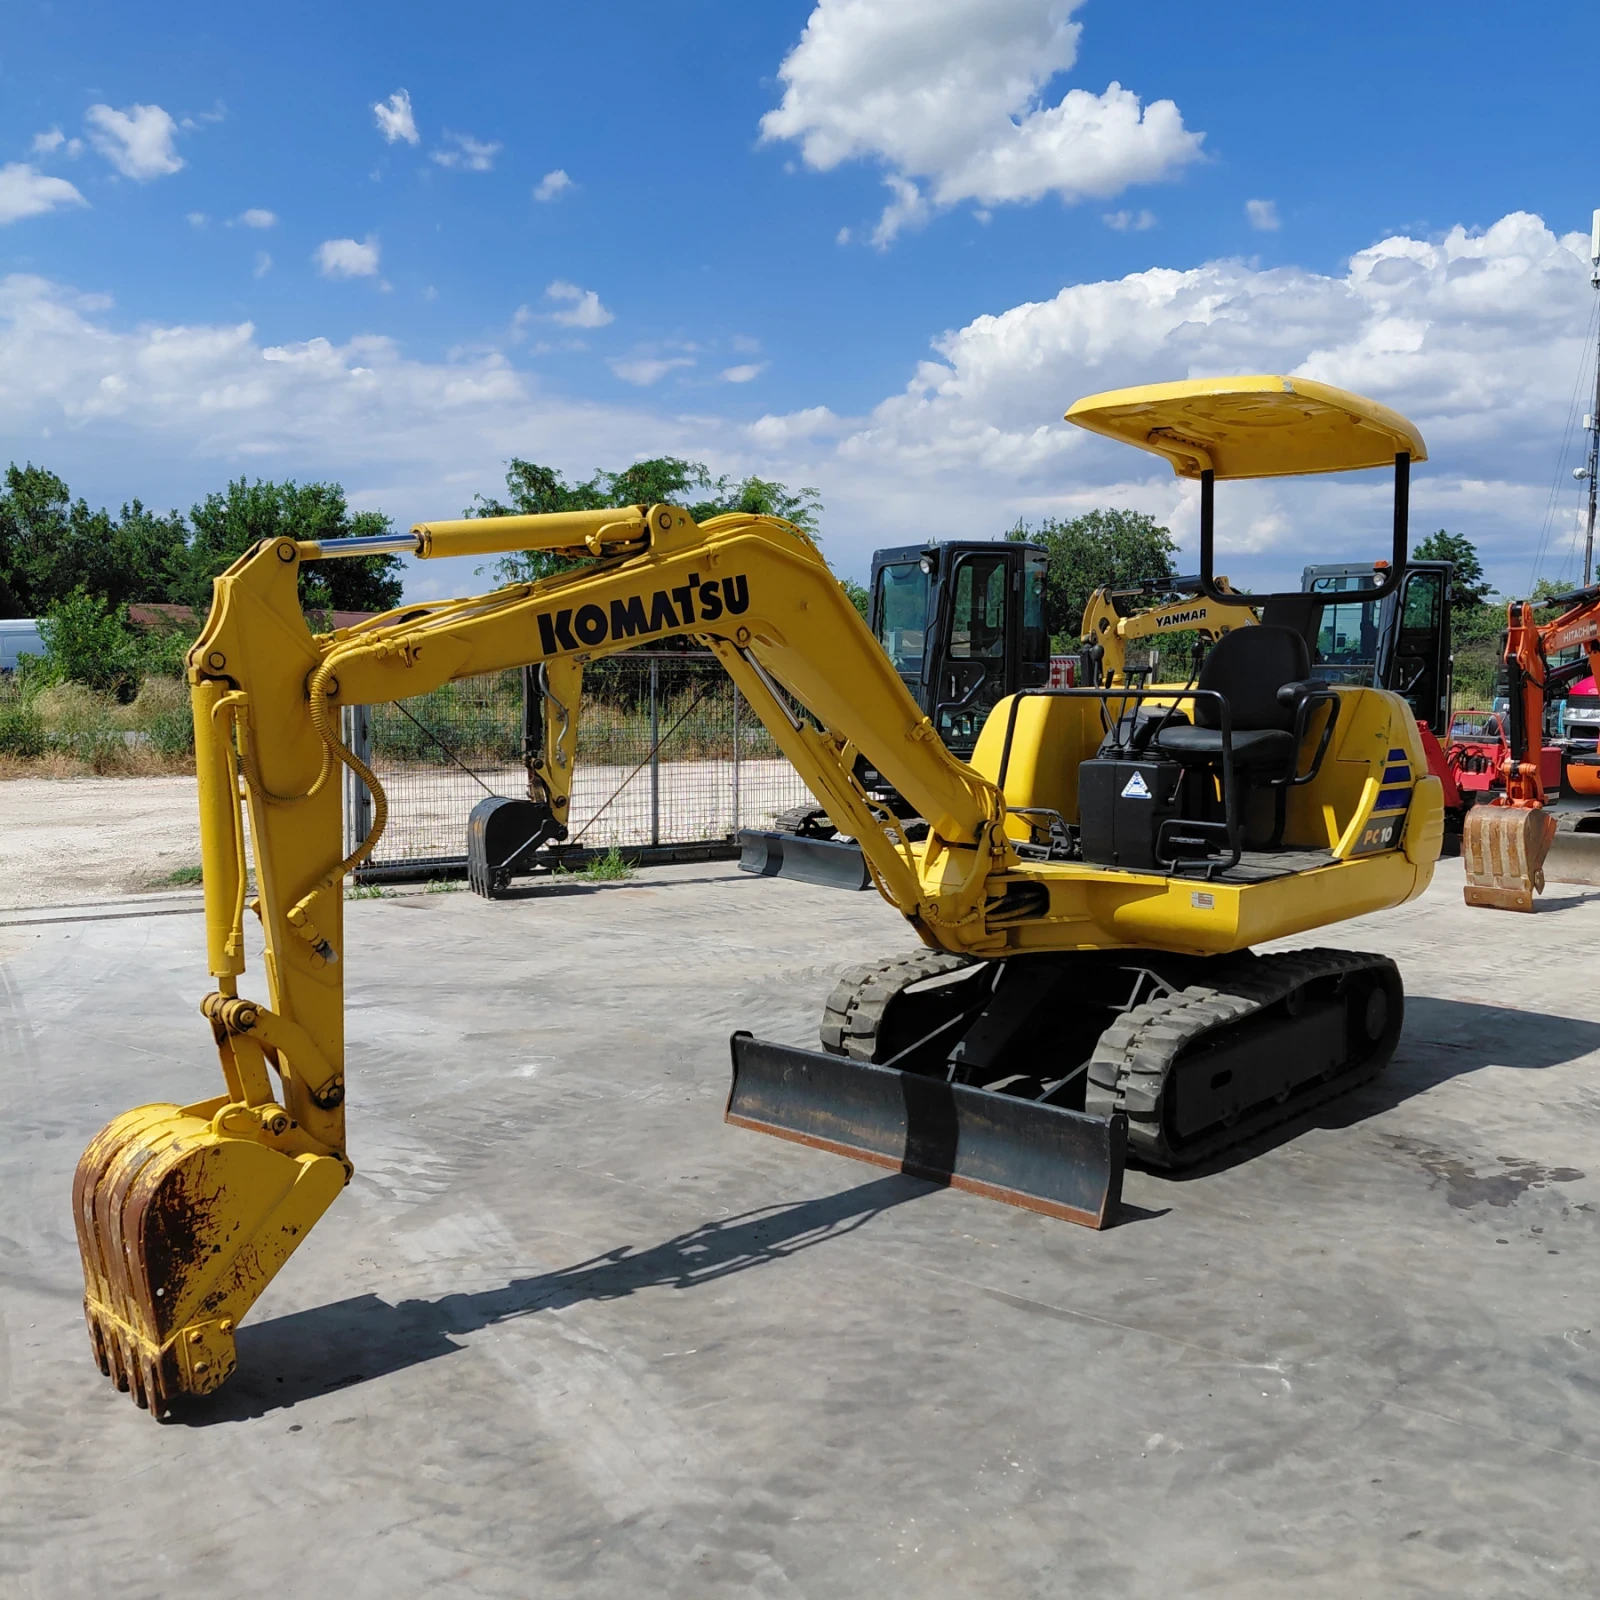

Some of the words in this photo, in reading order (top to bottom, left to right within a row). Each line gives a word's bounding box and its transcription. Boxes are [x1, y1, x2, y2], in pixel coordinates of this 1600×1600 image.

[536, 572, 750, 656] KOMATSU
[1155, 608, 1207, 628] YANMAR
[1563, 623, 1590, 643] HITACHI
